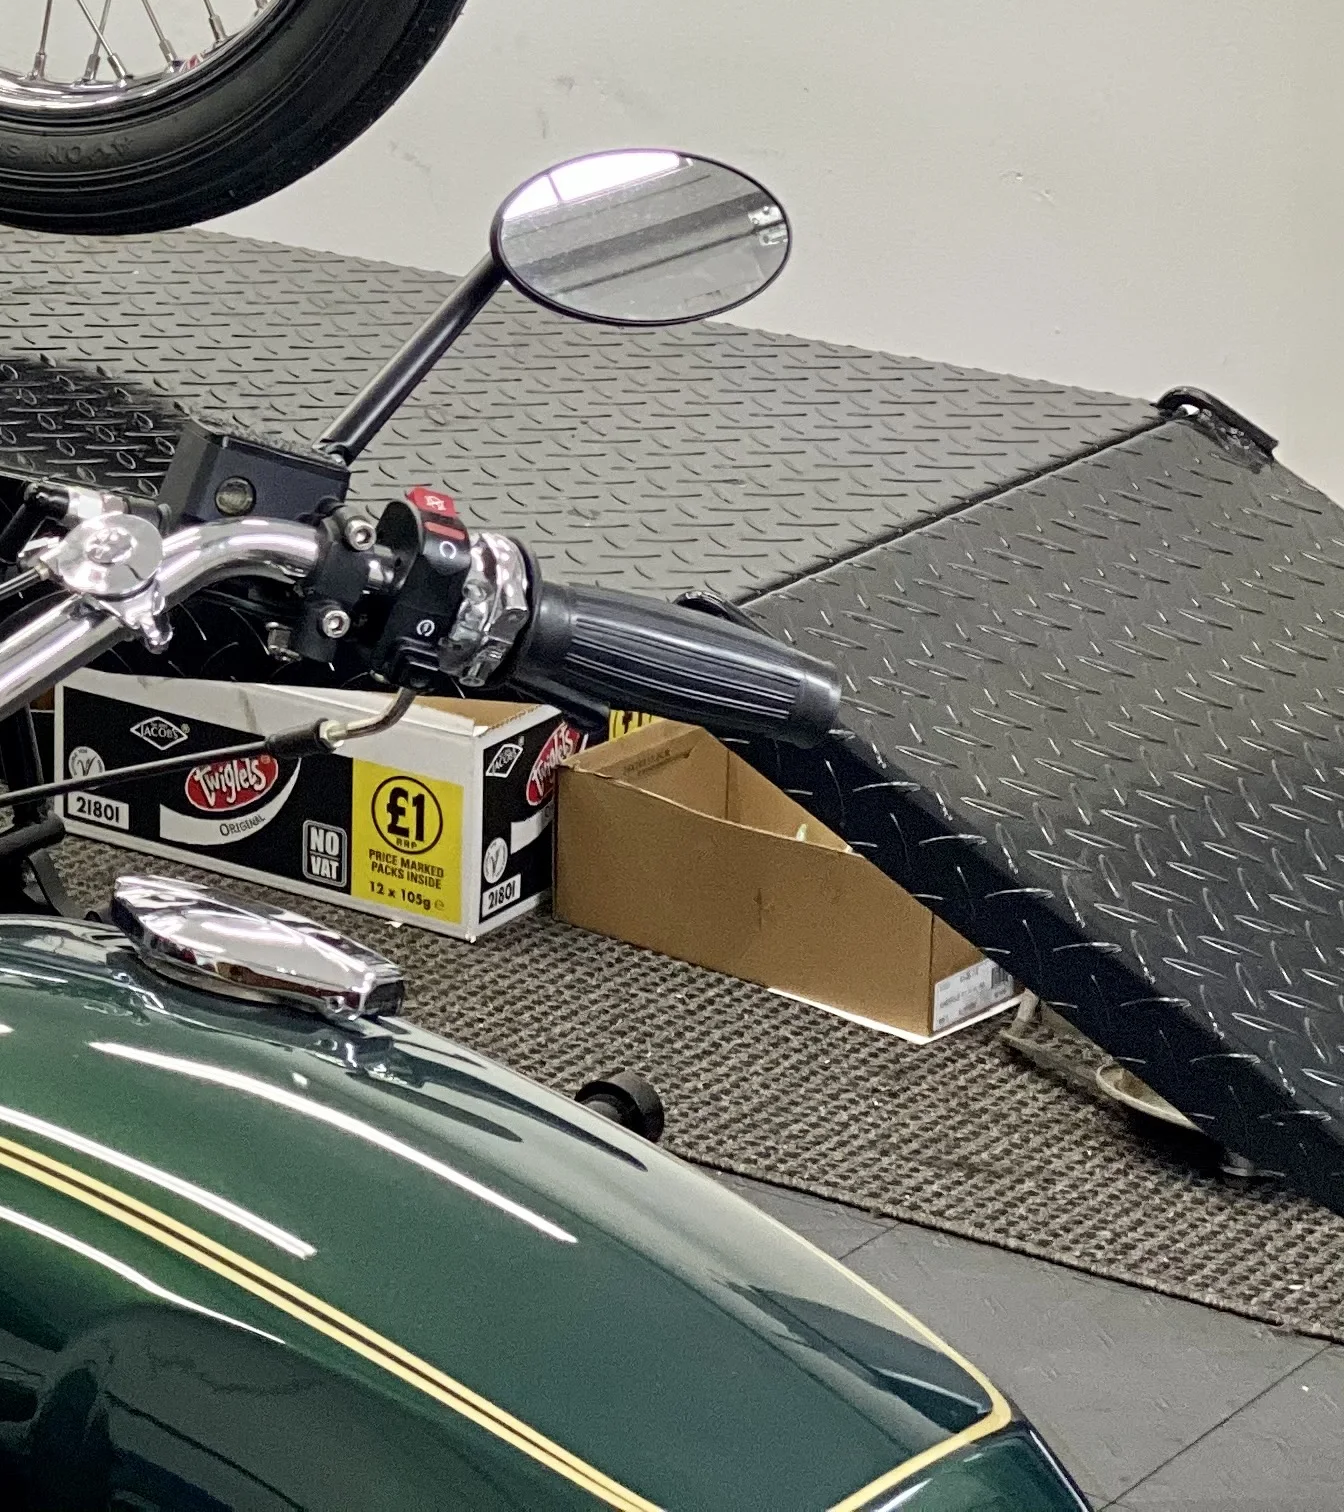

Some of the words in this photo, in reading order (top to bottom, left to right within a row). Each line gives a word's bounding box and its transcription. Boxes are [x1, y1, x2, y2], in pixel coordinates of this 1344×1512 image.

[192, 755, 267, 807] Twiglets
[76, 796, 120, 824] 21801
[386, 786, 426, 842] £1
[310, 826, 340, 857] NO
[396, 837, 418, 849] RRP
[310, 855, 340, 881] VAT
[368, 848, 398, 866] PRICE
[400, 856, 444, 878] MARKED
[371, 860, 405, 880] PACKS
[406, 870, 441, 890] INSIDE
[369, 880, 385, 895] 12
[400, 888, 431, 911] 105g
[488, 880, 516, 910] 21801
